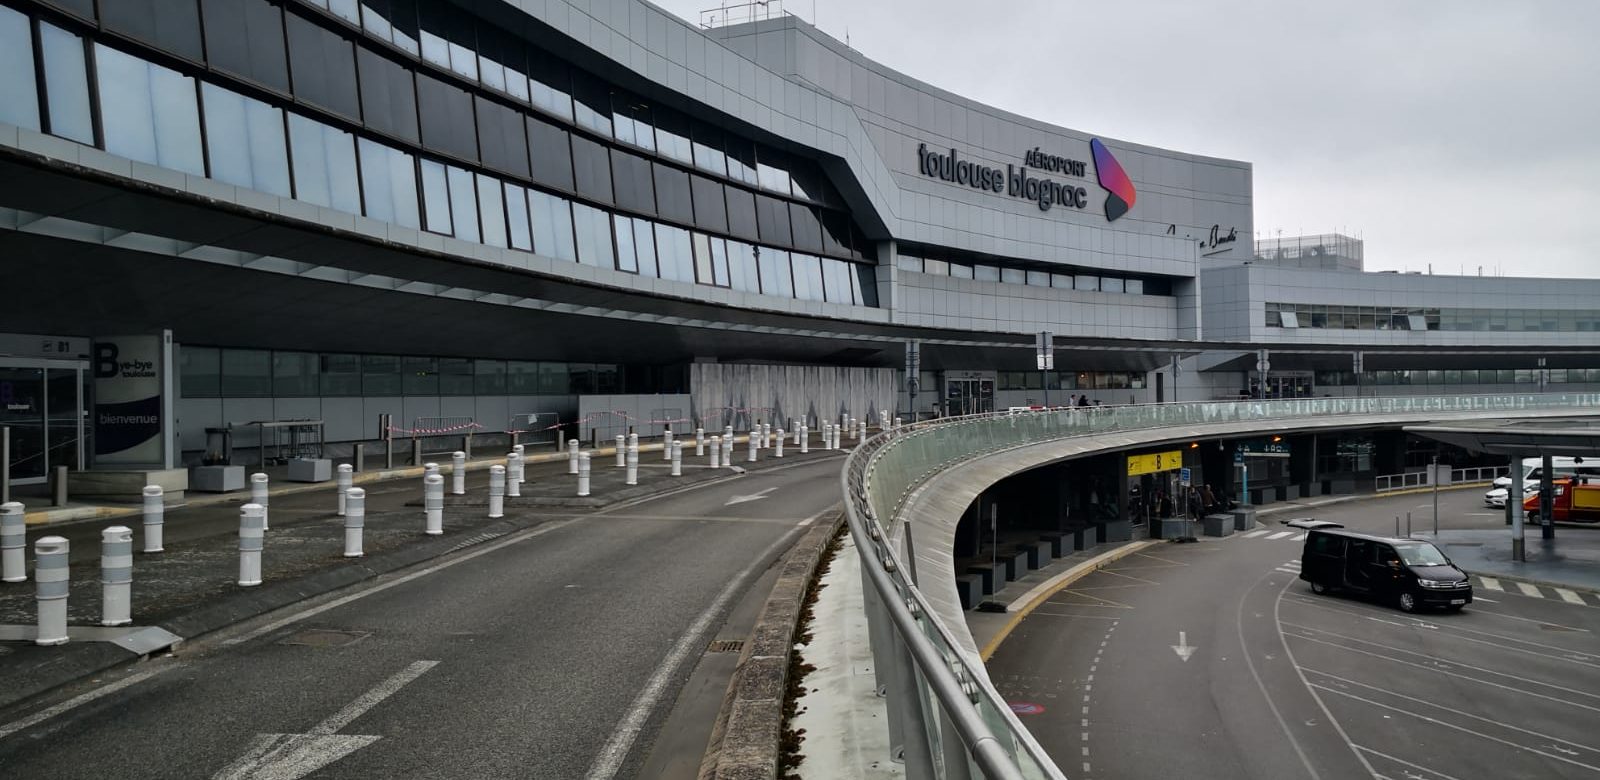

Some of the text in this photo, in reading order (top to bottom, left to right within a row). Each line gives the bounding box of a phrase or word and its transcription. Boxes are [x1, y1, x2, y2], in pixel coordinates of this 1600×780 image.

[1025, 147, 1087, 177] AÉROPORT
[918, 143, 1087, 211] toulouse blagnac
[99, 413, 158, 425] bienvenue
[1156, 455, 1162, 470] B
